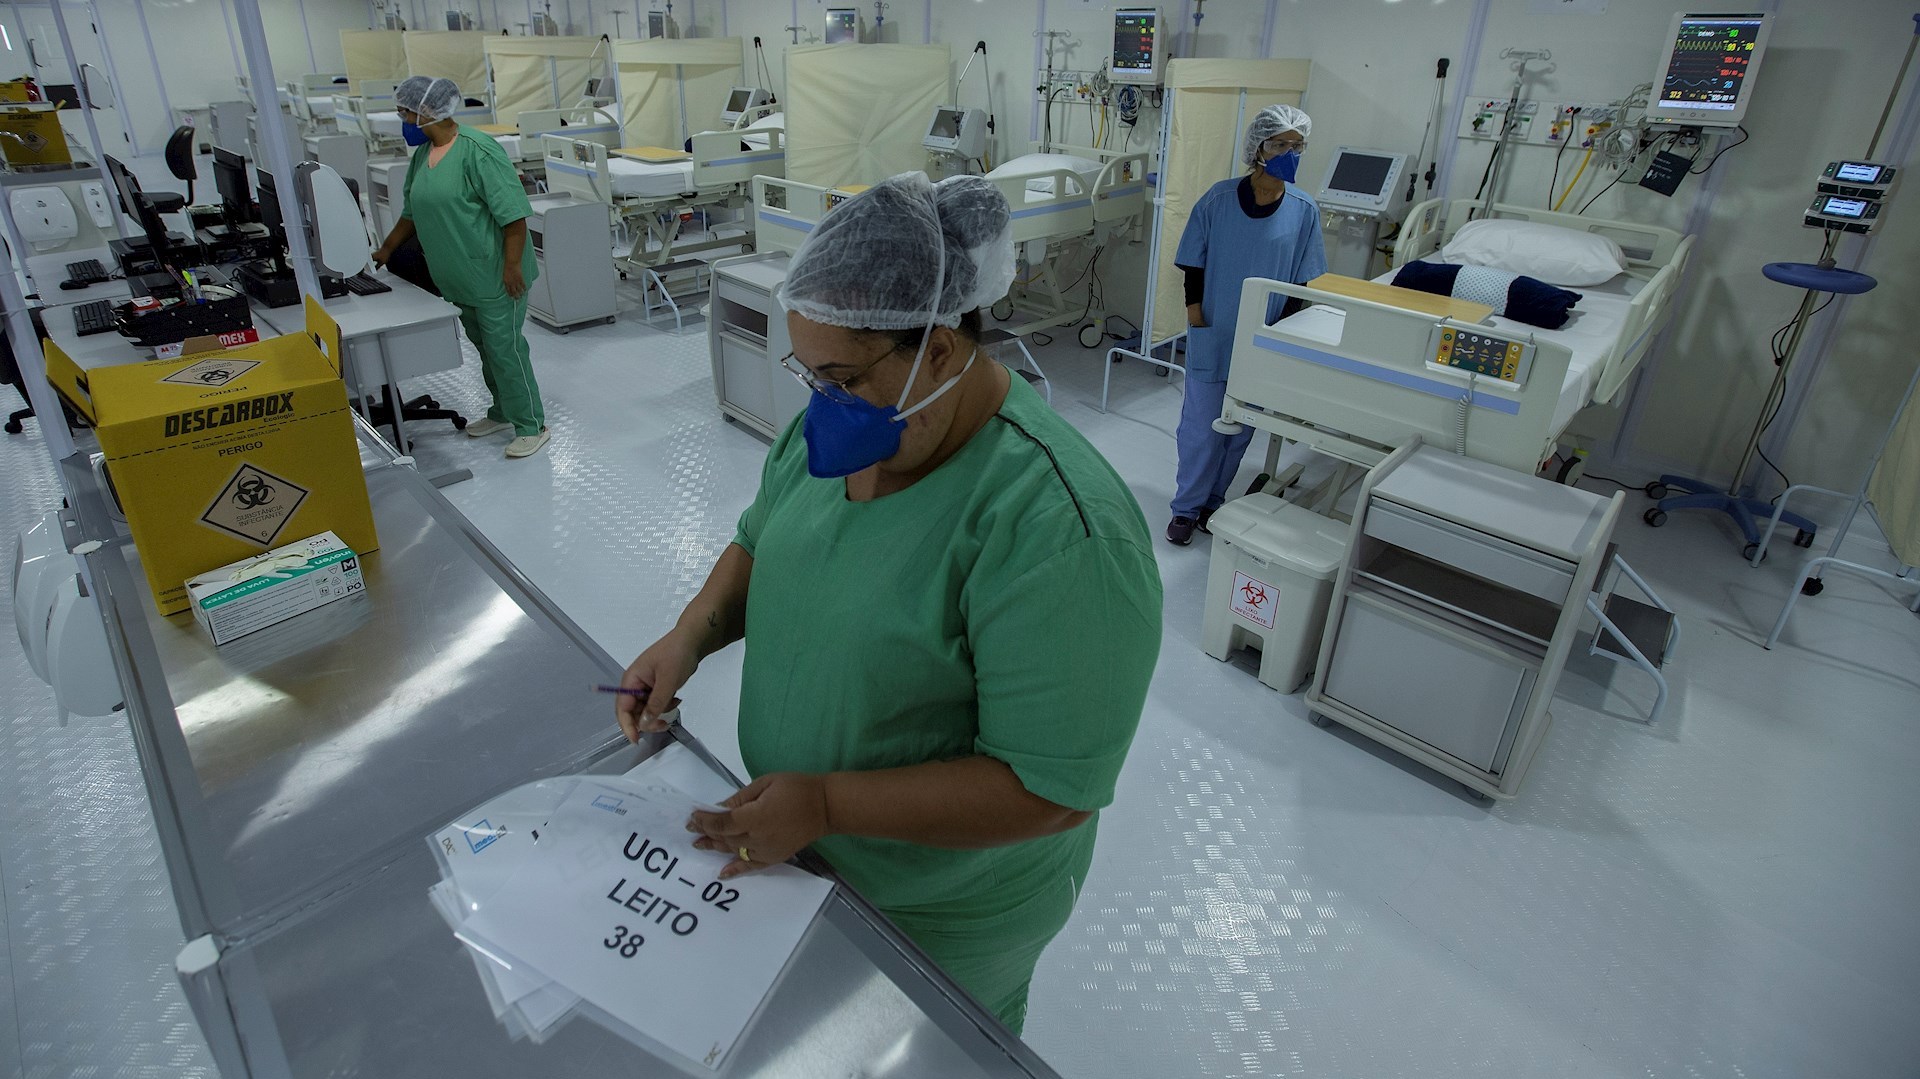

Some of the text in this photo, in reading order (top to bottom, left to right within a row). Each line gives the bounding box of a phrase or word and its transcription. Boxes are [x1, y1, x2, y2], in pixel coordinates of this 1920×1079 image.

[199, 386, 248, 398] PERIGO
[164, 391, 294, 438] DESCARBOX
[218, 440, 264, 457] PERIGO
[239, 511, 284, 527] INFECTANTE
[261, 530, 268, 538] 6
[342, 558, 355, 571] M
[344, 569, 359, 578] 100
[247, 578, 270, 590] LUVA
[347, 580, 362, 592] PÓ
[1235, 606, 1268, 624] INFECTANTE
[1245, 606, 1258, 615] LIXO
[623, 832, 679, 880] UCI
[701, 881, 739, 912] 02
[607, 878, 698, 936] LEITO
[603, 925, 645, 959] 38
